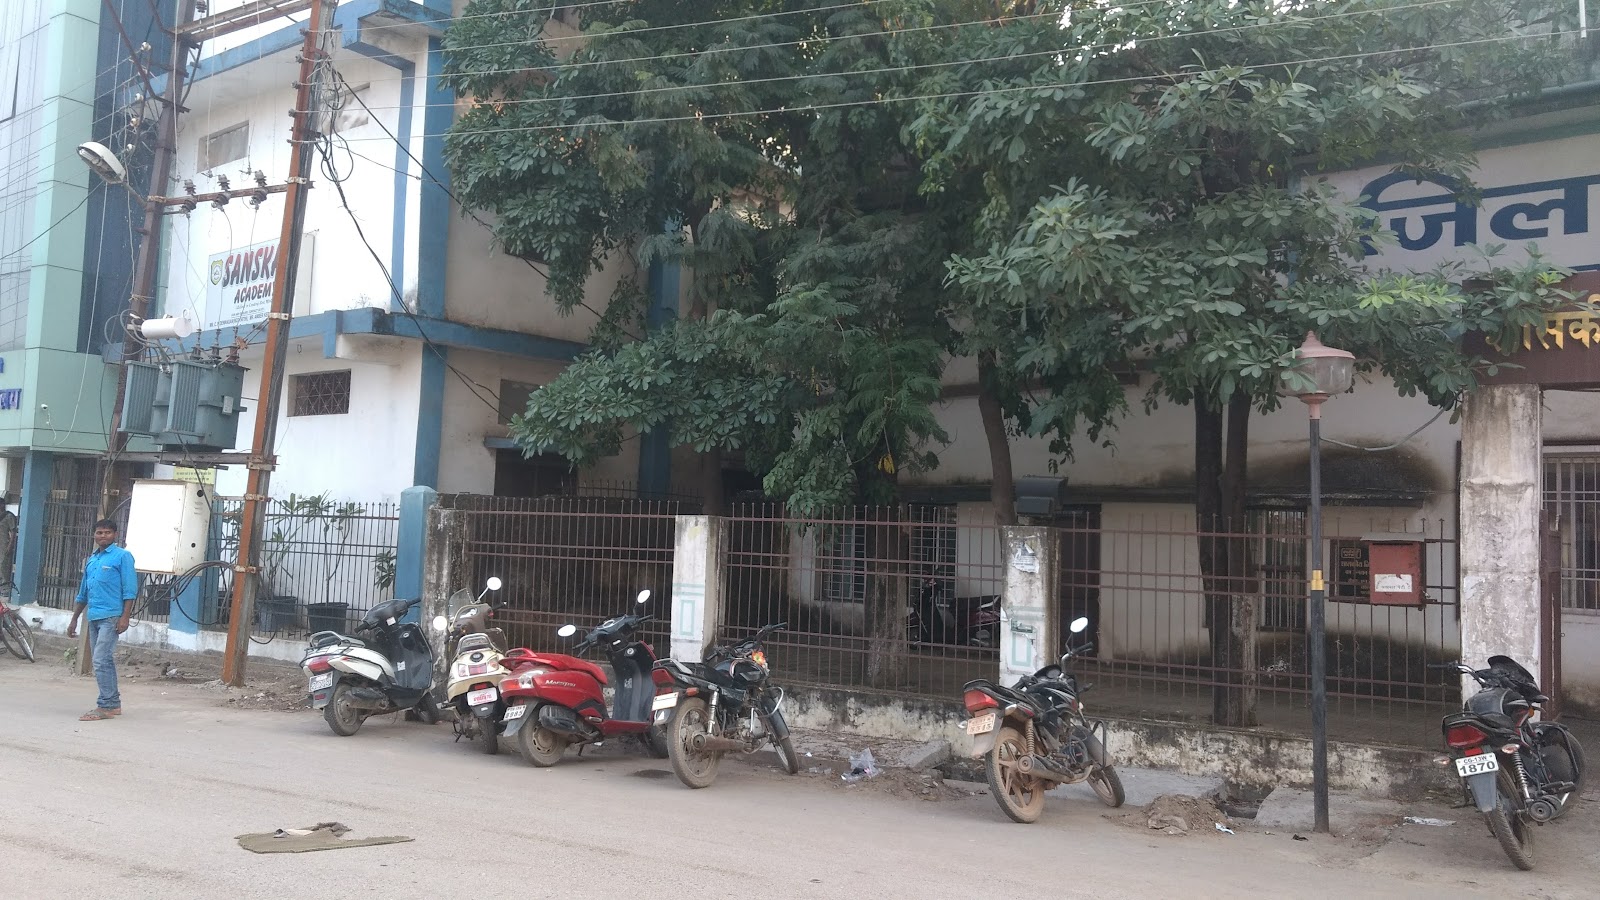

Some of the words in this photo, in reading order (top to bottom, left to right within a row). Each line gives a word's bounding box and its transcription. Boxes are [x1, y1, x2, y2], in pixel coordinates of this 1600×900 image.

[1359, 171, 1600, 256] जिल
[234, 281, 275, 304] ACADEM
[1460, 761, 1495, 774] 1870
